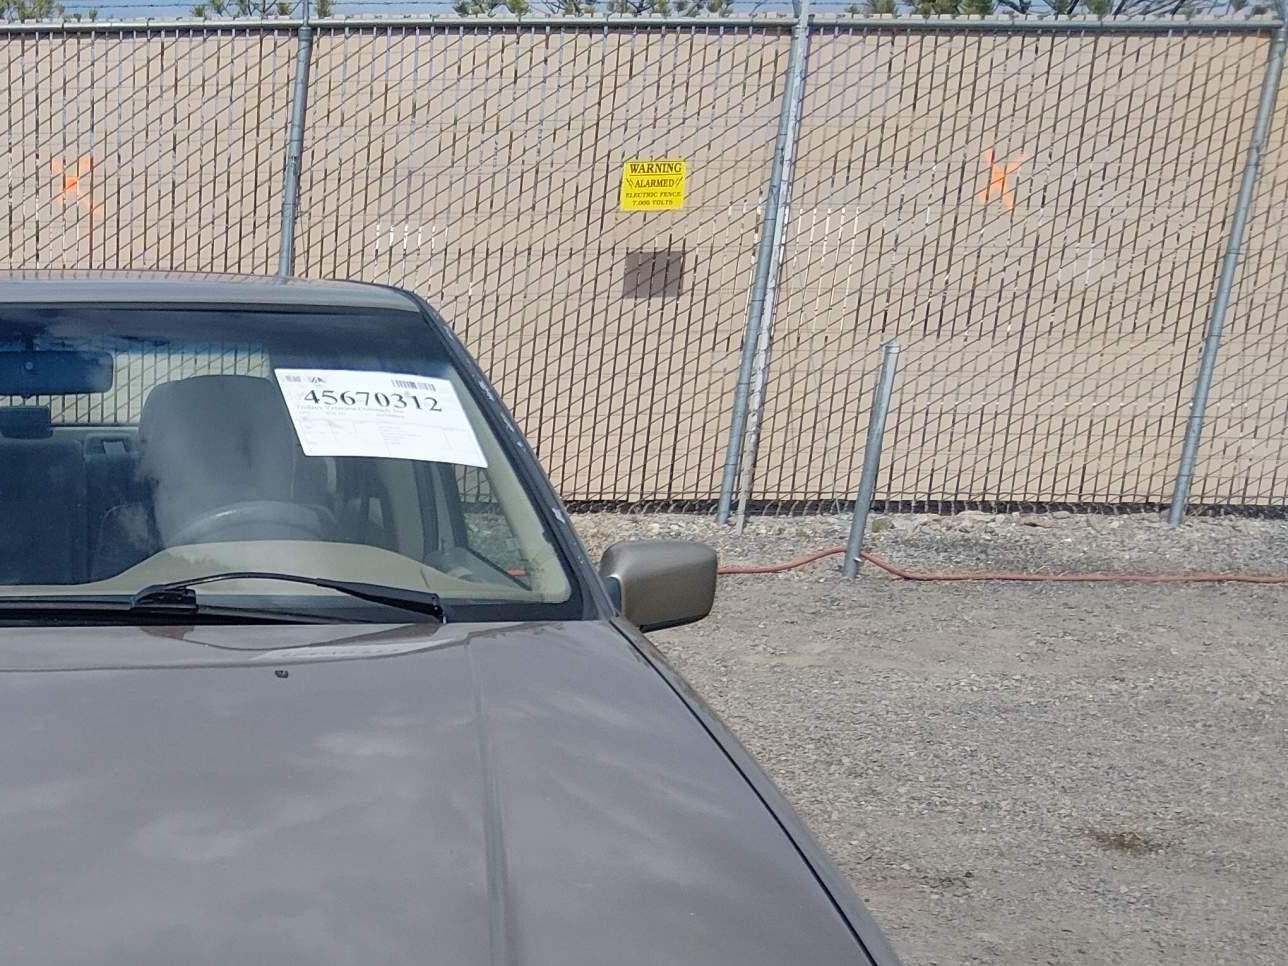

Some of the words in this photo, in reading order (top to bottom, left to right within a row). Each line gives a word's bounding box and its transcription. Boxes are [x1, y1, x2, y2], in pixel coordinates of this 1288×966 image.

[629, 163, 682, 174] WARNING
[634, 178, 675, 188] ALARMED
[303, 389, 443, 413] 45670312
